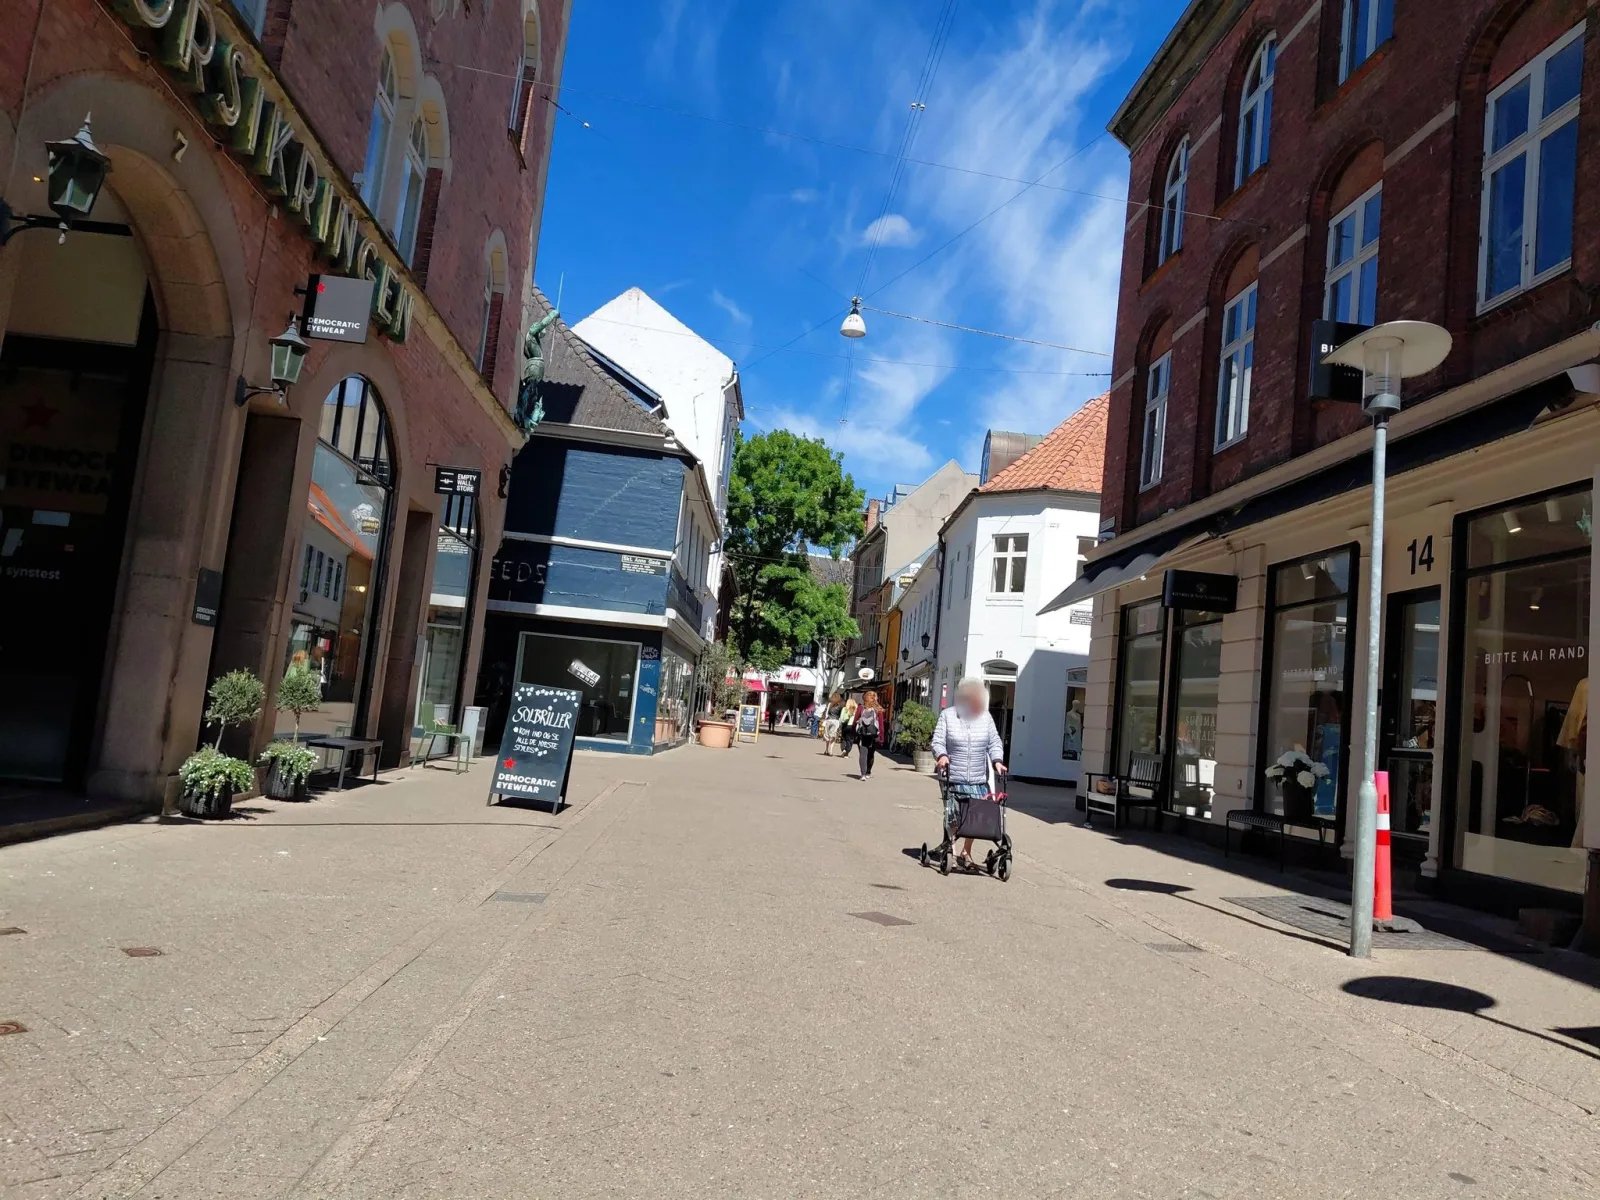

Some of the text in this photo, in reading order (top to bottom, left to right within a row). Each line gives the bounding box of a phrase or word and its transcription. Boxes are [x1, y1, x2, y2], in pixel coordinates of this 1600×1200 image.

[173, 130, 188, 163] 7
[308, 317, 360, 329] DEMOCRATIC
[306, 324, 345, 335] EYEWEAR
[457, 473, 477, 482] EMPTY
[457, 479, 473, 487] WALL
[1406, 534, 1434, 575] 14
[6, 565, 60, 580] synstest
[996, 650, 1003, 658] 12
[1484, 646, 1585, 664] BITTE KAI RAND
[785, 670, 801, 681] H&M
[512, 705, 573, 729] SOLBRILLER
[518, 726, 531, 737] KOM
[531, 729, 543, 738] IND
[542, 731, 551, 740] OG
[516, 736, 529, 746] ALLE
[529, 738, 537, 746] DE
[513, 744, 536, 754] STYLES
[498, 772, 557, 788] DEMOCRATIC
[496, 781, 540, 794] EYEWEAR
